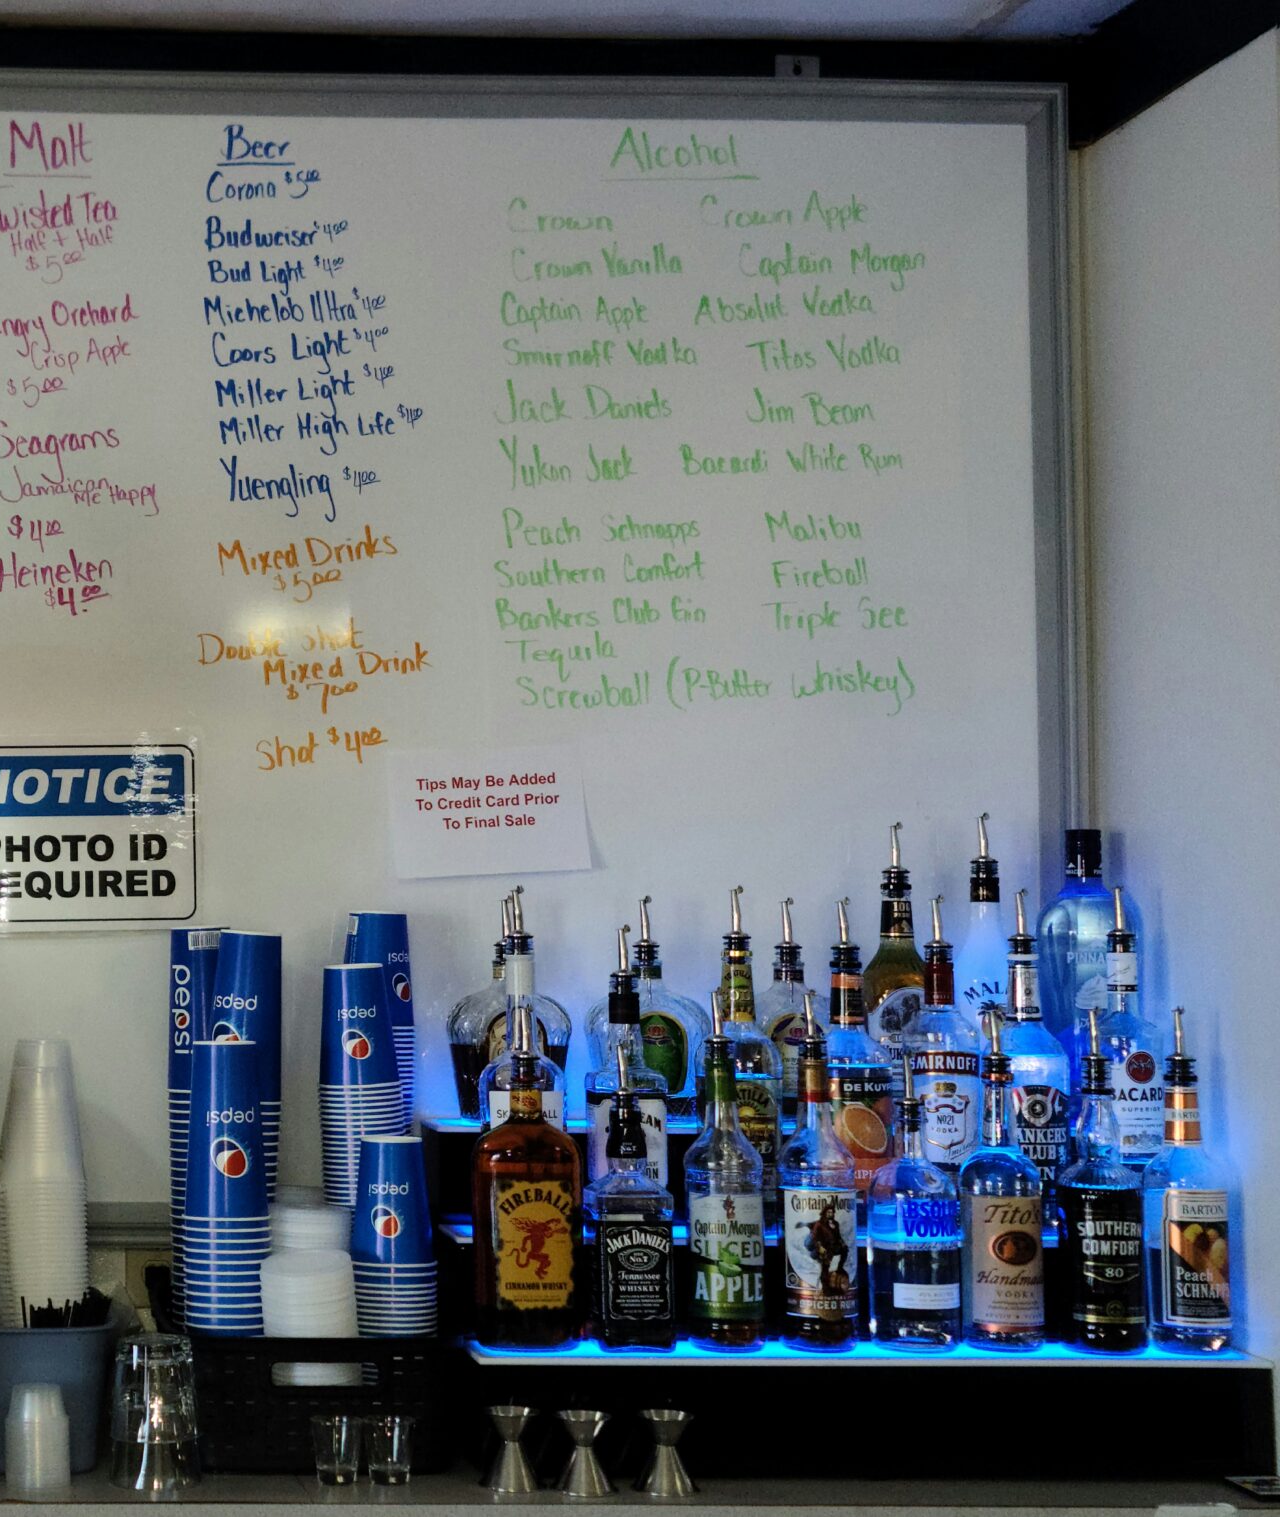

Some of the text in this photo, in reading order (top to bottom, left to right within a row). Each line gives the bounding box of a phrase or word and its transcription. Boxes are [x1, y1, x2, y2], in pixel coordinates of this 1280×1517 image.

[9, 120, 93, 171] Malt
[220, 124, 291, 160] Beer
[610, 126, 739, 172] Alcohol
[206, 171, 276, 203] Corona
[76, 192, 119, 224] Tea
[10, 225, 113, 256] Half Half
[205, 215, 319, 251] Budweiser
[207, 259, 307, 296] Bud Light
[511, 241, 684, 283] Crown Vanilla
[739, 242, 926, 292] Captain Morgan
[51, 293, 140, 327] Orchard
[203, 290, 357, 326] Michelob Ultra
[30, 335, 131, 374] Crisp Apple
[212, 329, 351, 374] Coors Light
[503, 336, 698, 367] Smirnoff Vodka
[745, 334, 900, 372] Titos Vodka
[215, 370, 355, 418] Miller Light
[493, 378, 673, 425] Jack Daniels
[219, 412, 396, 456] Miller High Life
[0, 465, 110, 503] Jamaican
[109, 483, 160, 517] Happy
[219, 455, 337, 522] Yuengling
[764, 510, 863, 543] Malibu
[217, 524, 398, 576] Mixed Drinks
[494, 551, 707, 588] Southern Comfort
[771, 556, 868, 588] Fireball
[263, 642, 433, 686] Mixed Drink
[256, 731, 319, 771] Shot
[416, 772, 556, 793] Tips May Be Added
[415, 792, 560, 811] To Credit Card Prior
[443, 814, 536, 830] To Final Sale
[128, 834, 168, 862] ID
[171, 964, 192, 1055] pepsi
[214, 994, 259, 1012] pepsi
[337, 1004, 377, 1022] pepsi
[910, 1054, 977, 1071] SMIRNOFF
[205, 1105, 255, 1127] pepsi
[368, 1181, 410, 1198] pepsi
[498, 1188, 571, 1217] FIREBALL
[791, 1194, 827, 1213] Captain
[984, 1204, 1040, 1226] Tito's
[1181, 1203, 1224, 1215] BARTON
[606, 1229, 670, 1254] JACK DANIEL'S
[694, 1218, 760, 1238] Captain Morgan
[904, 1219, 959, 1238] VODKA
[1077, 1219, 1142, 1238] SOUTHERN
[1082, 1238, 1140, 1256] COMFORT
[695, 1271, 764, 1303] APPLE
[1105, 1267, 1124, 1278] 80
[1176, 1266, 1213, 1283] Peach
